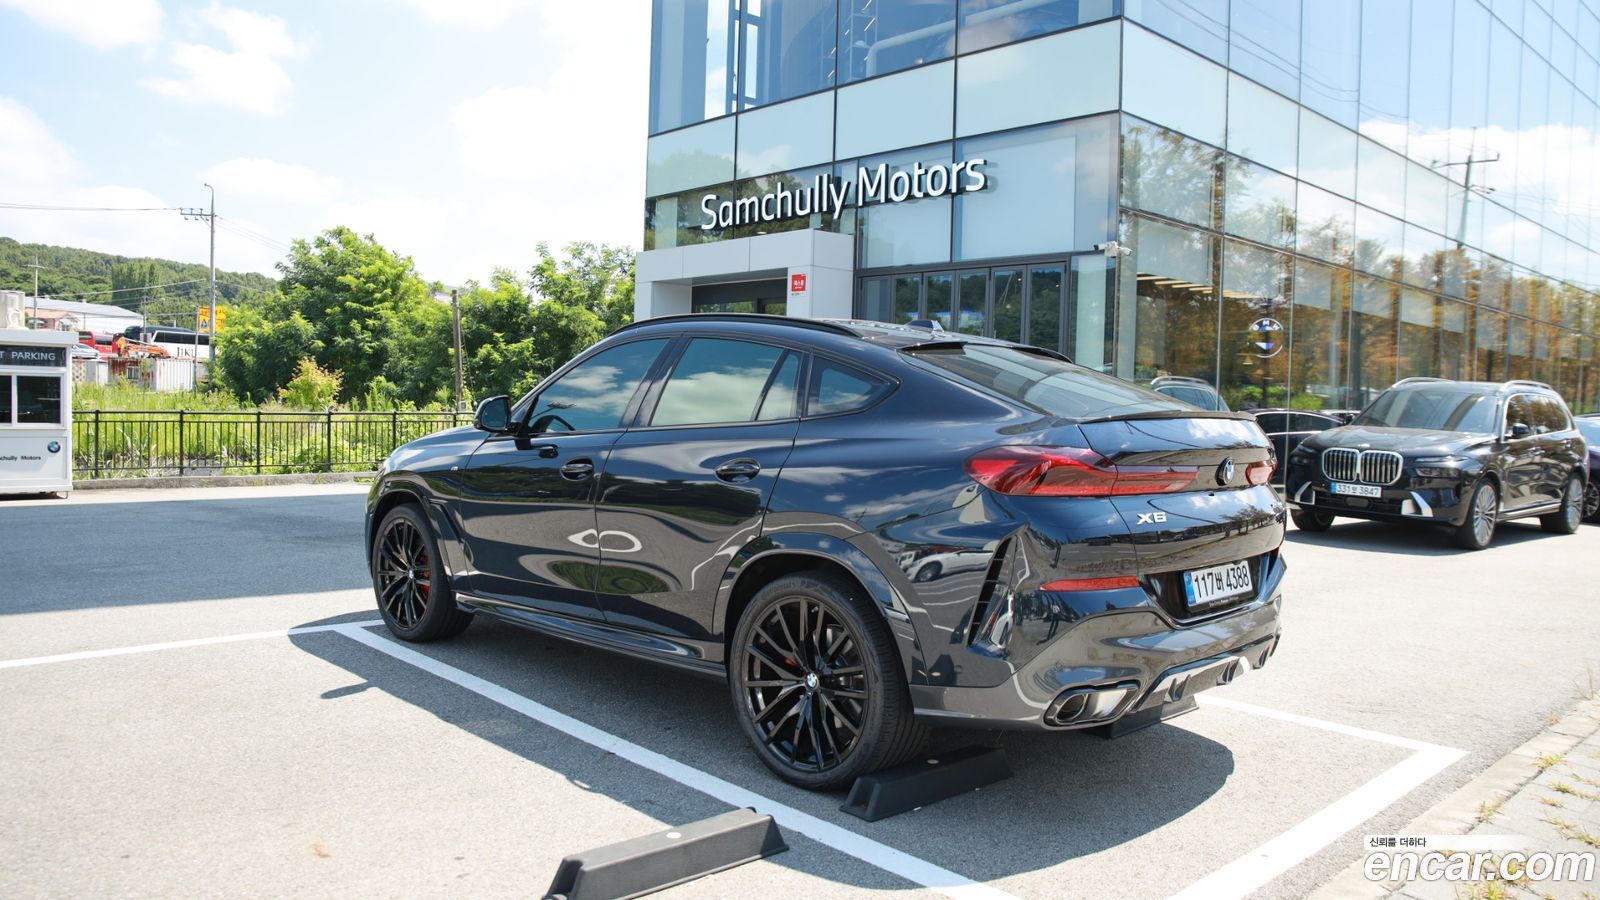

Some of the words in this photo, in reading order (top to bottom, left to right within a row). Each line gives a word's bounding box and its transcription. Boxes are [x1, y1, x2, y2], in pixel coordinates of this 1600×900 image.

[701, 174, 849, 230] Samchully
[858, 158, 987, 207] Motors
[11, 351, 56, 361] PARKING
[1360, 486, 1379, 496] 3847
[1137, 512, 1167, 525] X6
[1195, 571, 1224, 599] 117버
[1226, 565, 1250, 591] 4388
